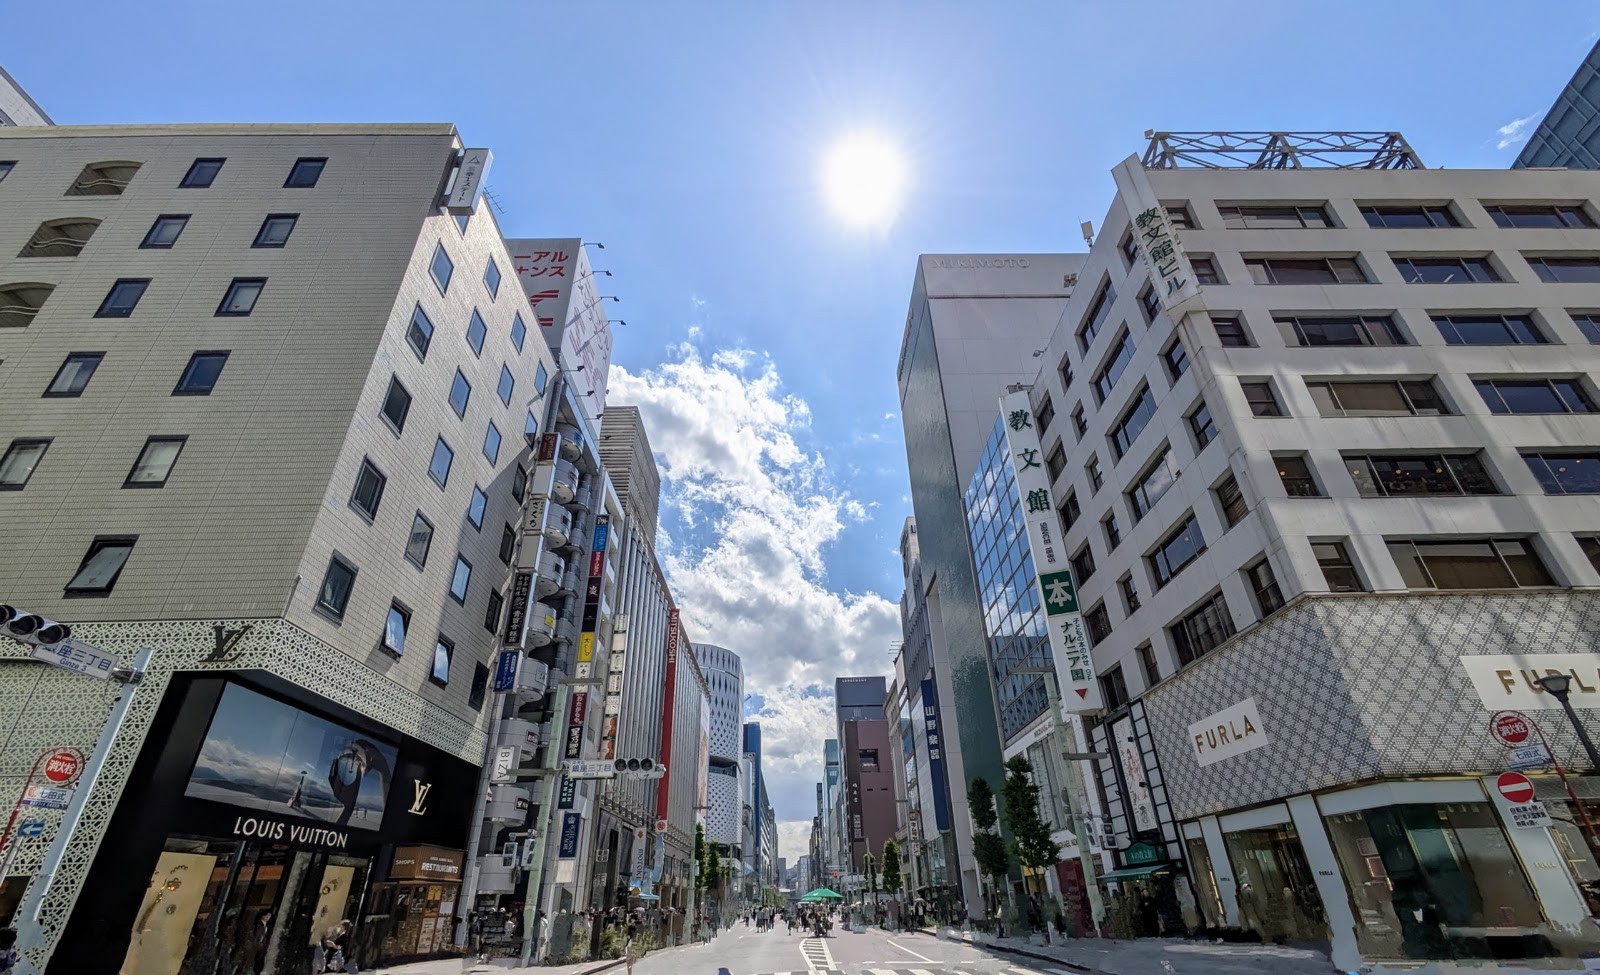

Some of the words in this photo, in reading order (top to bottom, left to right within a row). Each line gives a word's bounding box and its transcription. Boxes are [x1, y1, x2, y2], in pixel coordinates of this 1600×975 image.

[931, 257, 1031, 269] MIKIMOTO
[1136, 206, 1187, 296] 教文館ビル
[1008, 409, 1050, 514] 教文館
[1039, 521, 1051, 545] SINCE
[1045, 578, 1073, 607] 本
[668, 611, 678, 664] MITSUKOSHI
[1060, 621, 1085, 682] ナルニア国
[1072, 617, 1090, 667] 子どもの本のみせ
[59, 657, 80, 669] Ginza
[1495, 667, 1600, 695] FUL
[925, 705, 940, 760] 山野楽器
[1194, 714, 1257, 754] FURLA
[1498, 721, 1527, 737] 消火栓
[46, 759, 76, 775] 消火栓
[571, 764, 611, 773] 銀座三丁目
[1516, 749, 1541, 760] 七田式
[39, 790, 67, 801] 七田式
[233, 816, 285, 840] LOUIS
[290, 824, 348, 849] VUITTON
[421, 862, 459, 874] RESTAURANTS
